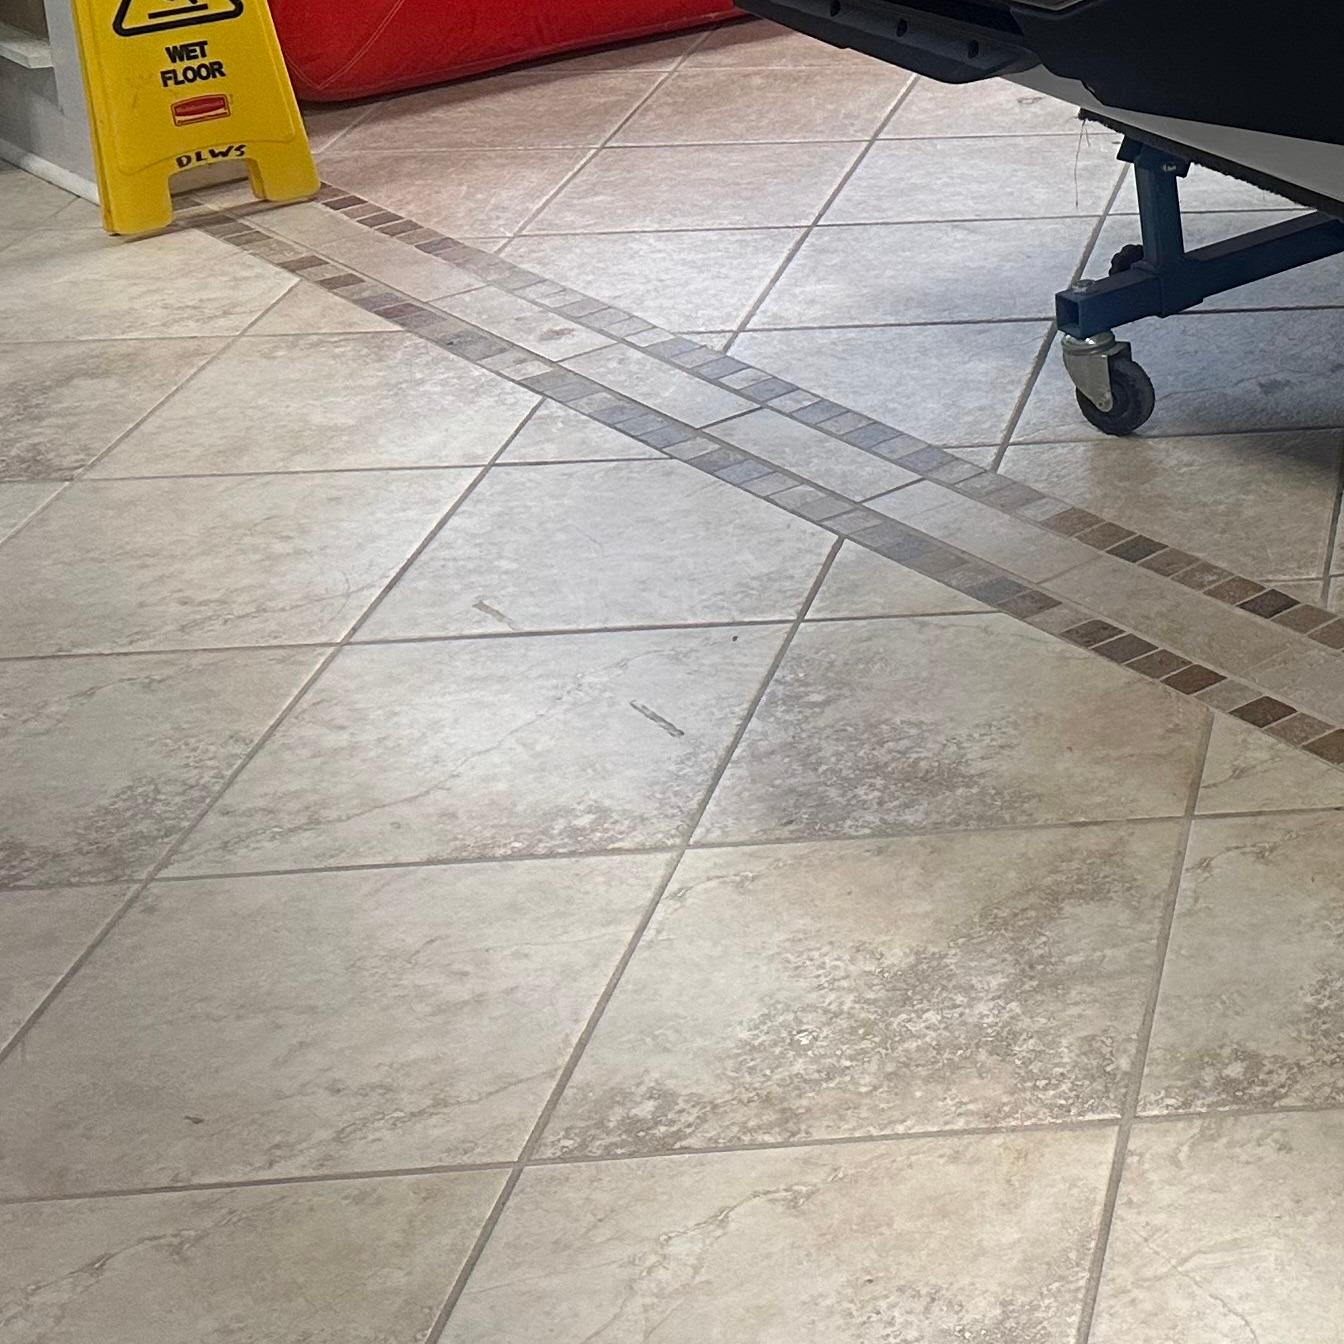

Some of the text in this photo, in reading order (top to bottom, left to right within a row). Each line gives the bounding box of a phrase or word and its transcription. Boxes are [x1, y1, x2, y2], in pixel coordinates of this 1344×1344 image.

[165, 40, 208, 64] WET
[160, 60, 226, 88] FLOOR
[176, 144, 246, 168] DLWS
